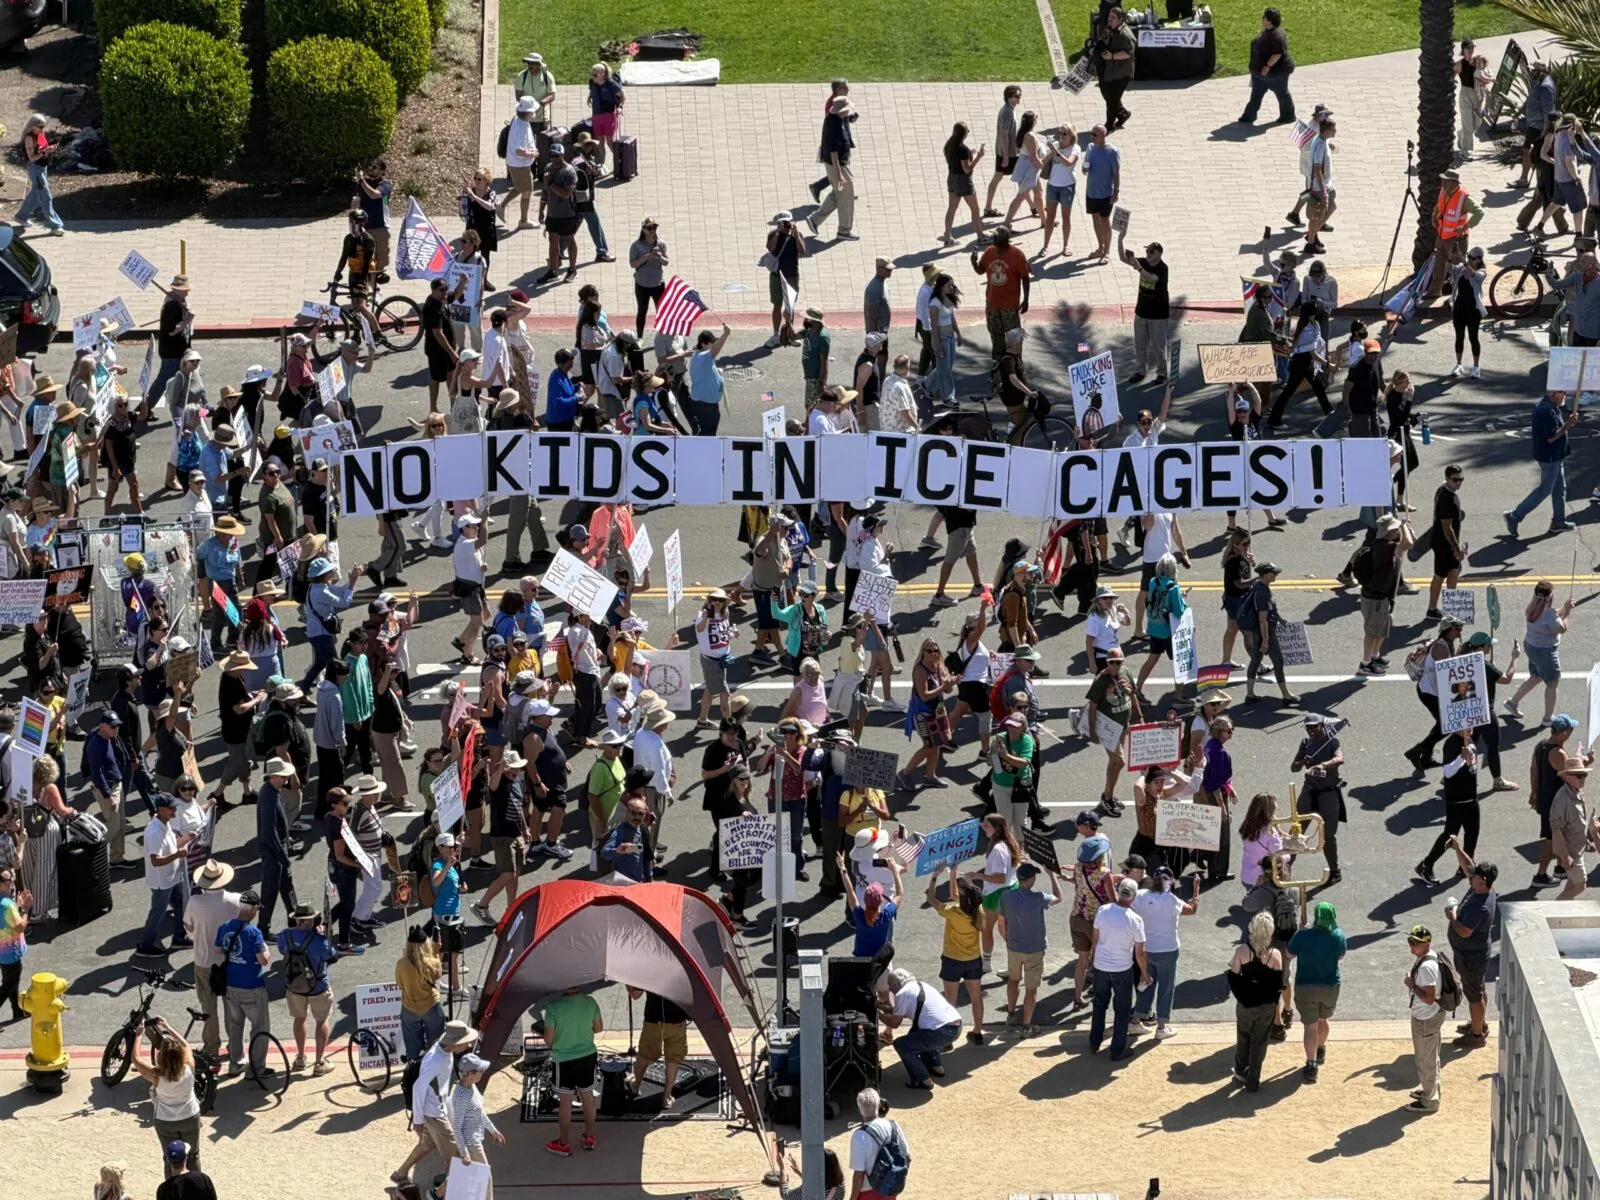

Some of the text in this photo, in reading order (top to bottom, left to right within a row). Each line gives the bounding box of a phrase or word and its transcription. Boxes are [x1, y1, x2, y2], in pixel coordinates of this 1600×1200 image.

[1071, 355, 1112, 384] FAUX-KING
[1080, 373, 1106, 396] JOKE
[344, 434, 1325, 515] NO KIDS IN ICE CAGES!
[50, 568, 86, 584] DOMESTIC
[546, 556, 571, 587] FIRE
[1437, 653, 1481, 671] DOES THIS
[1449, 664, 1475, 682] ASS
[1447, 697, 1482, 713] MAKE MY
[1443, 713, 1490, 732] LOOK SMALL
[1448, 706, 1483, 722] COUNTRY
[1162, 802, 1204, 813] CALIFORNIA
[724, 818, 741, 829] THE
[725, 830, 776, 847] DESTROYIN
[929, 834, 974, 856] KINGS
[724, 840, 776, 857] THE COUNTRY
[738, 849, 752, 857] ARE
[729, 856, 763, 867] BILLION
[362, 996, 386, 1005] FIRED
[360, 1058, 400, 1069] DICTATRS
